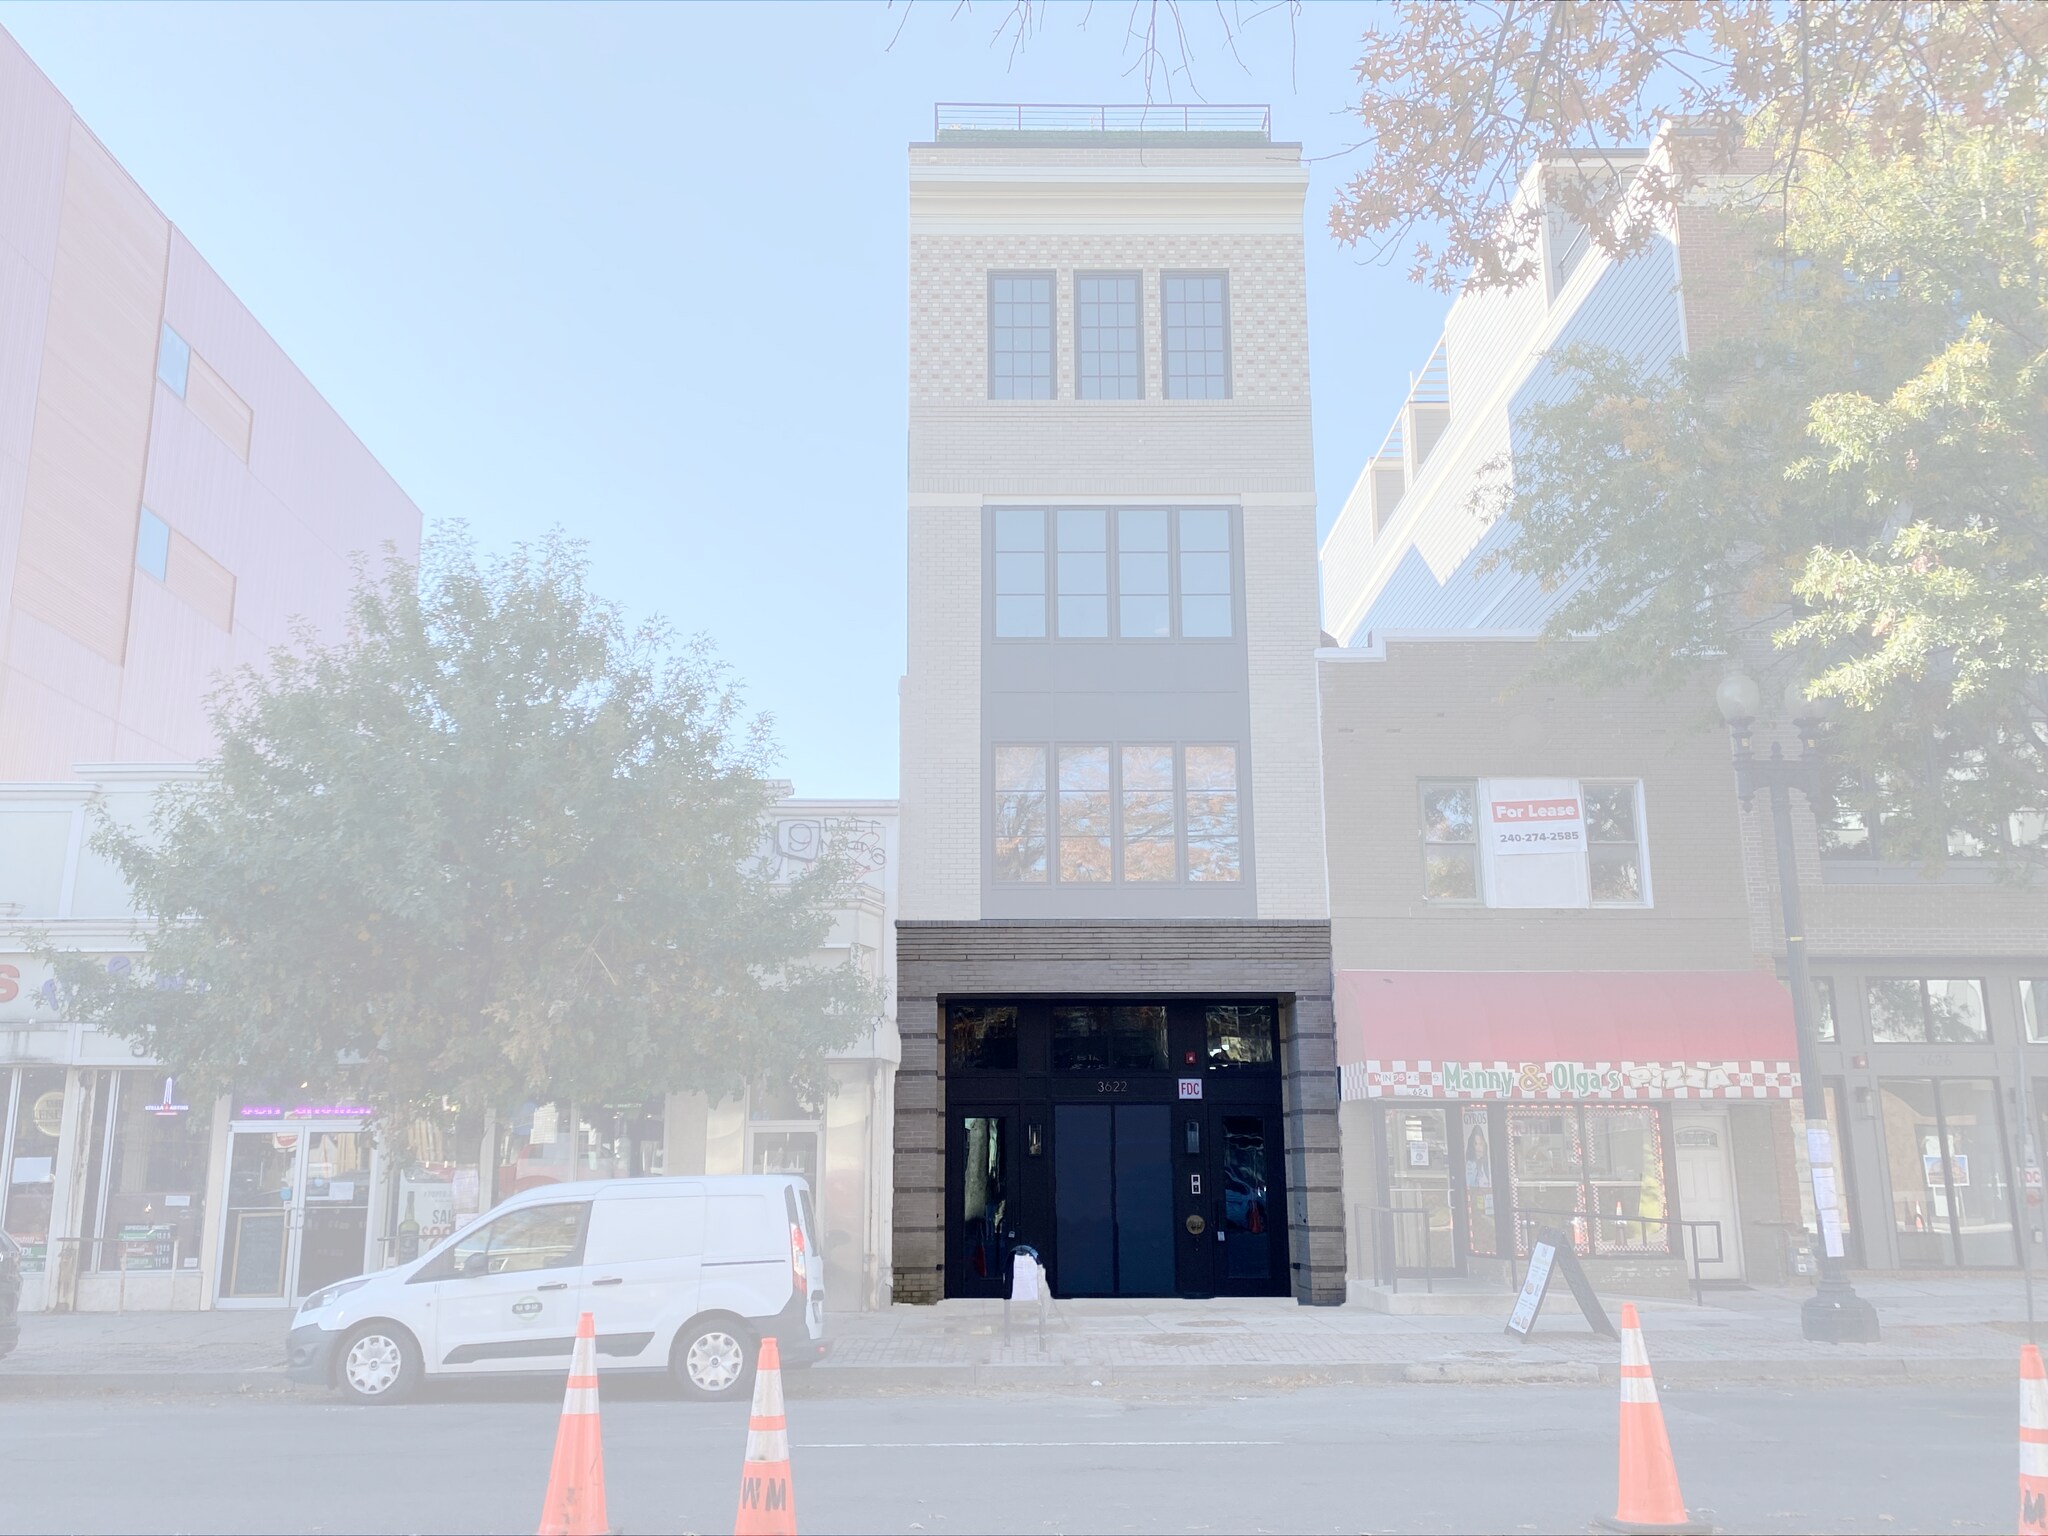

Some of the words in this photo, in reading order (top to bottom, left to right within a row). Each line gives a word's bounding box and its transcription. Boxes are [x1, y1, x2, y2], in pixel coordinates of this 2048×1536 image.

[1496, 805, 1525, 819] For
[1528, 803, 1576, 818] Lease
[1499, 831, 1580, 844] 240-274-2585
[1443, 1063, 1513, 1095] Manny
[1519, 1063, 1549, 1091] &
[1552, 1063, 1621, 1096] Olga's
[1097, 1080, 1128, 1093] 3622
[1181, 1082, 1200, 1095] FDC
[1463, 1112, 1487, 1125] GYROS
[2023, 1171, 2040, 1183] DC
